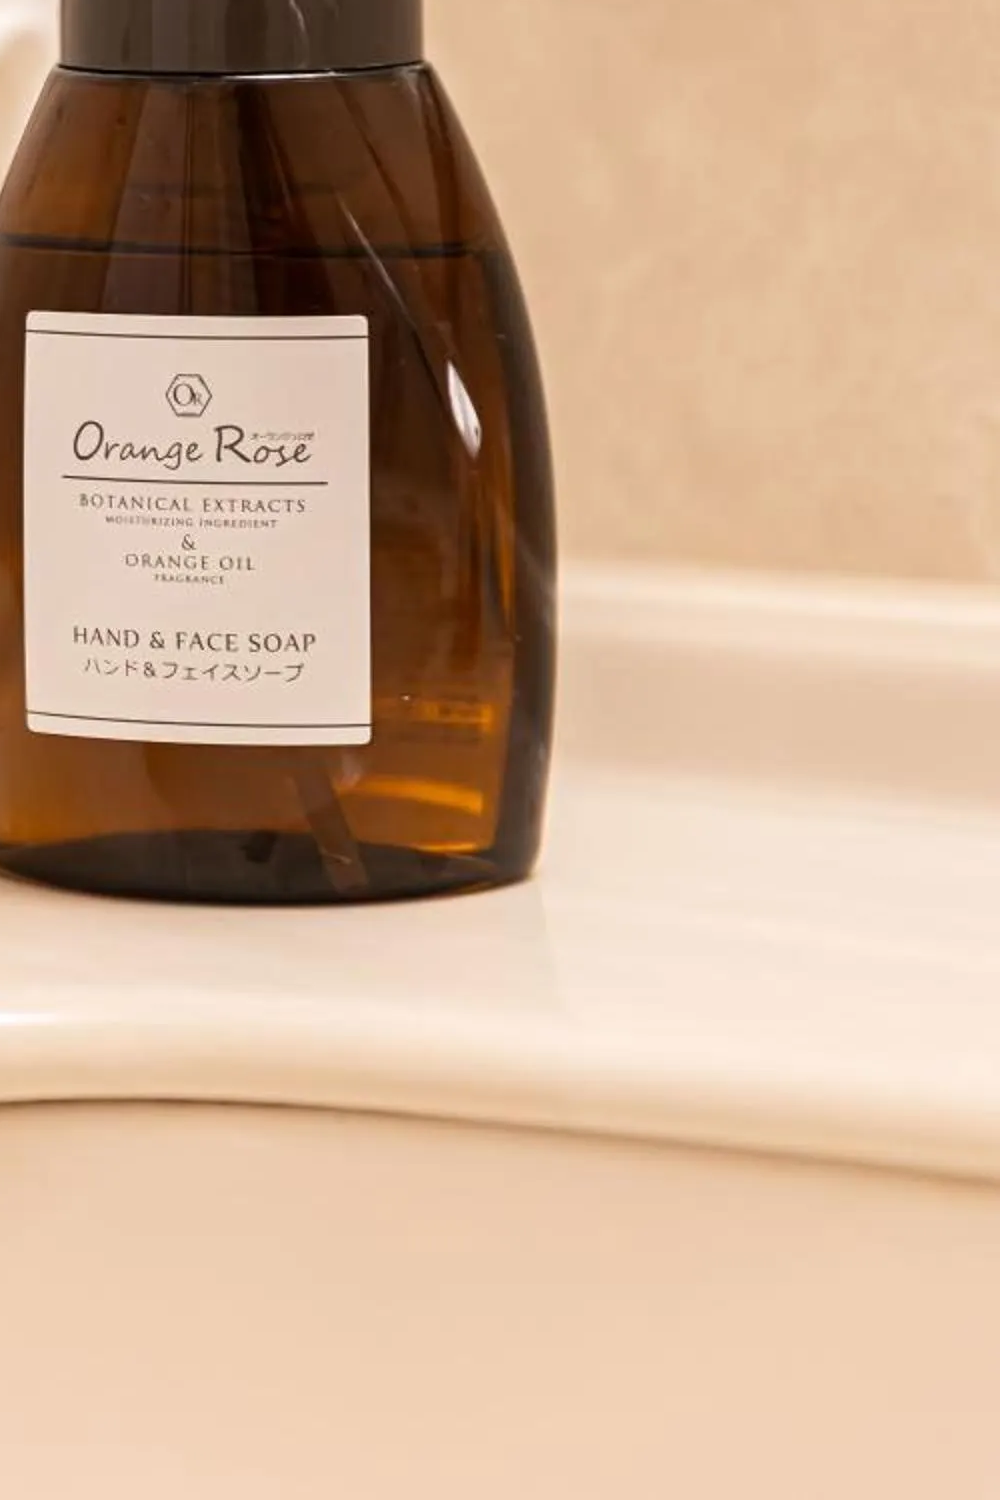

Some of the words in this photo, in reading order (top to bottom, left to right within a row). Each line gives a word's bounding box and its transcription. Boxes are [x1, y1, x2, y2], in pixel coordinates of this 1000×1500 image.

[73, 420, 203, 470] Orange
[213, 424, 312, 467] Rose
[79, 493, 192, 512] BOTANICAL
[202, 498, 307, 514] EXTRACTS
[105, 515, 194, 528] MOISTURIZING
[199, 518, 278, 529] INGREDIENT
[181, 534, 198, 551] &
[125, 554, 210, 571] ORANGE
[219, 556, 256, 571] OIL
[154, 573, 225, 586] FRAGRANCE
[72, 625, 140, 648] HAND
[149, 630, 166, 650] &
[175, 631, 239, 653] FACE
[249, 633, 317, 653] SOAP
